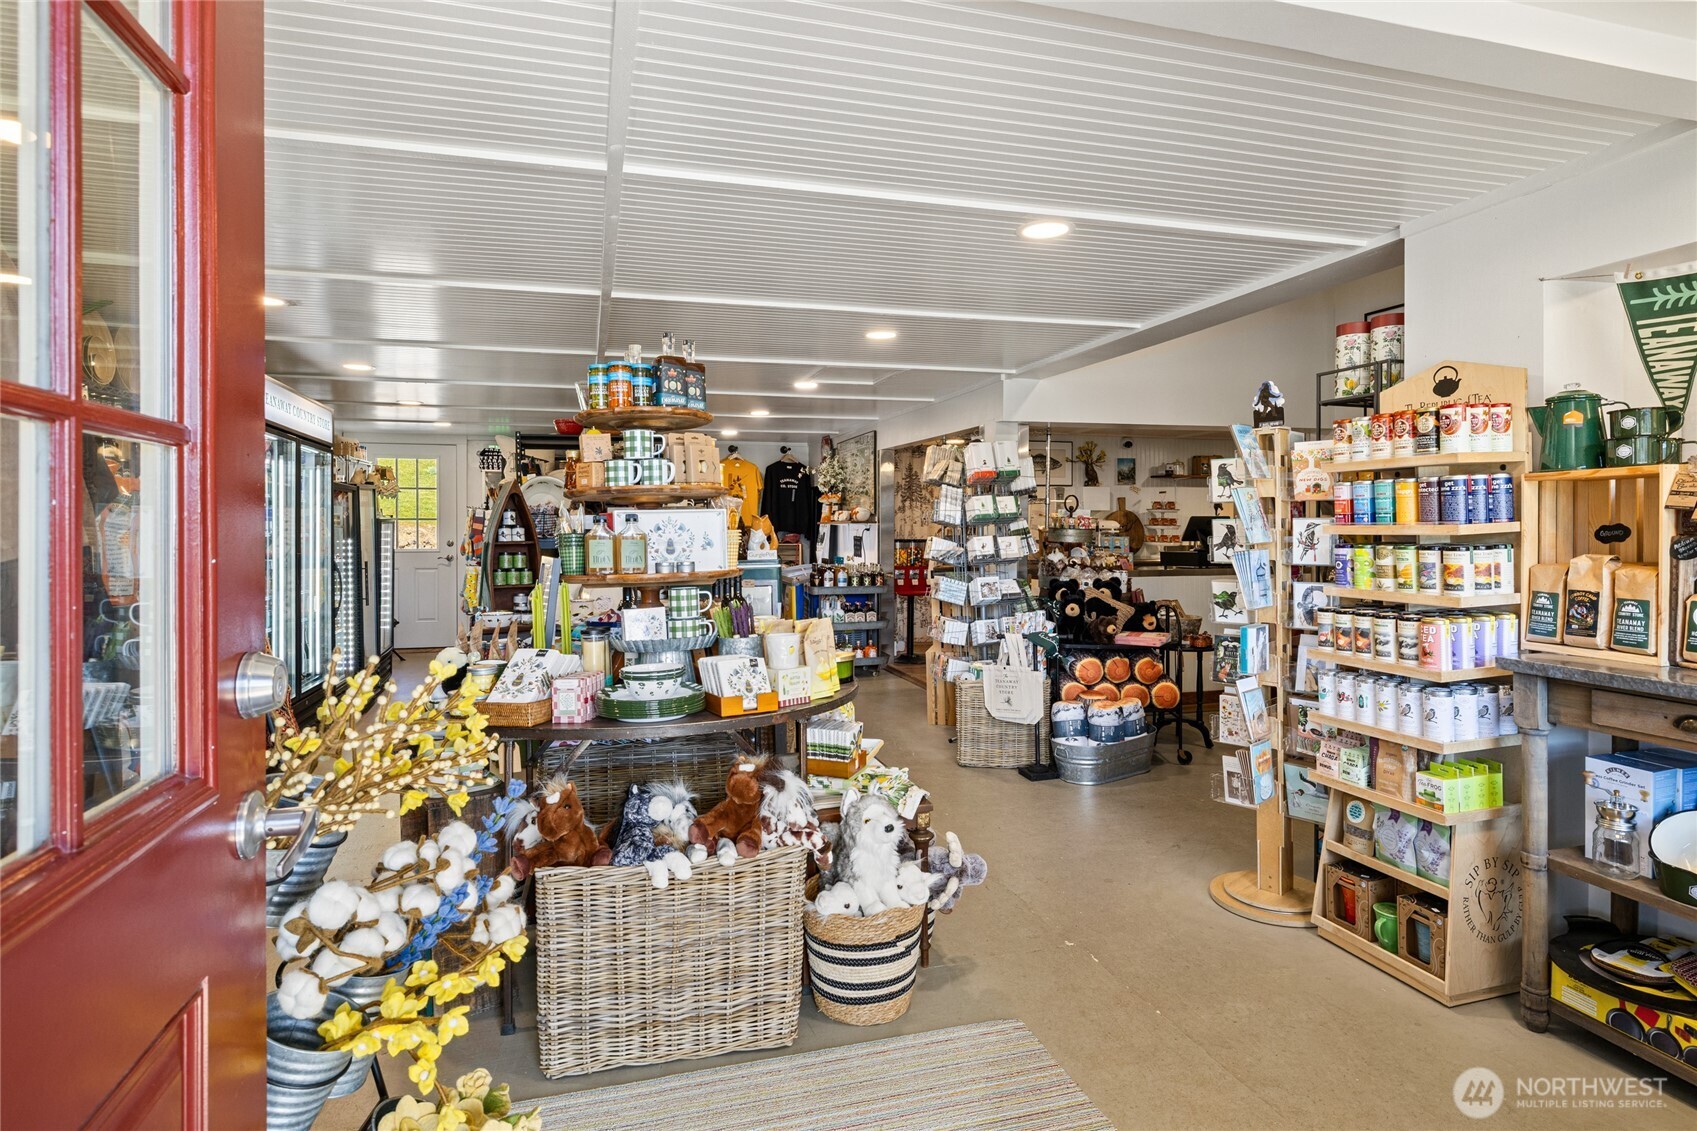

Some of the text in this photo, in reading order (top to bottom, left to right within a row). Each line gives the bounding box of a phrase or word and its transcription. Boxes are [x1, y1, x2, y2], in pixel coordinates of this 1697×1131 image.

[265, 392, 291, 415] EANAWAY
[1599, 529, 1625, 538] GROUND
[1673, 537, 1695, 551] Medium
[1616, 618, 1646, 627] TEANAWAY
[1603, 775, 1618, 783] Coffee
[1464, 857, 1520, 889] SIP BY SIP
[1462, 896, 1477, 934] RATHER
[1475, 930, 1497, 944] THAN
[1497, 924, 1515, 943] GULP
